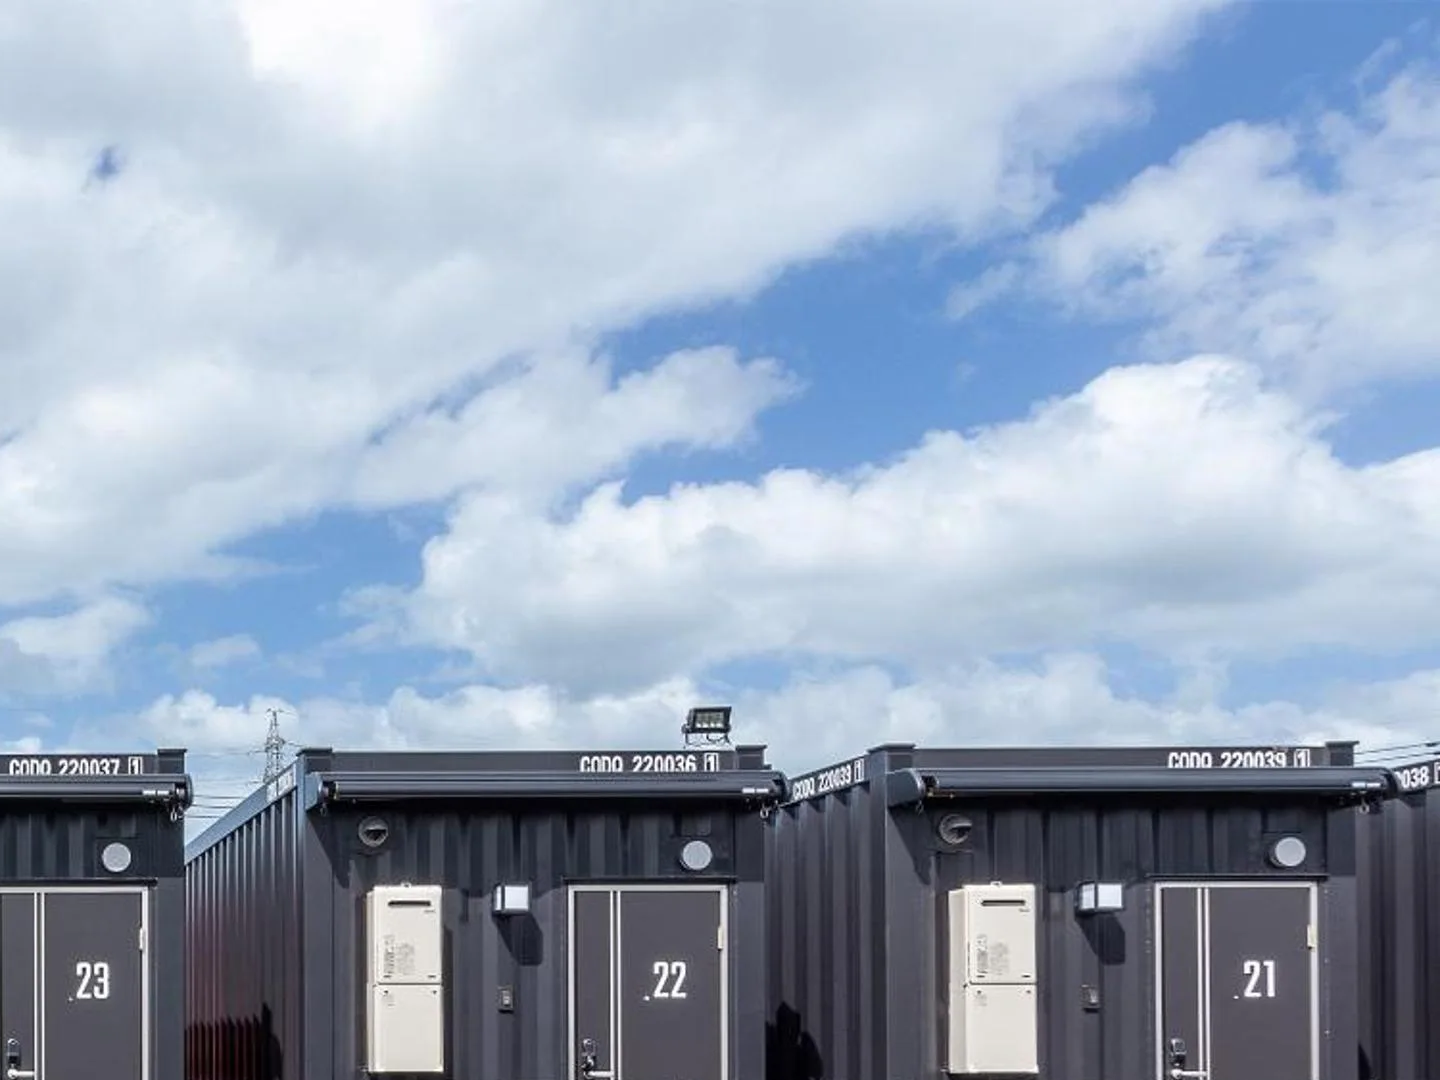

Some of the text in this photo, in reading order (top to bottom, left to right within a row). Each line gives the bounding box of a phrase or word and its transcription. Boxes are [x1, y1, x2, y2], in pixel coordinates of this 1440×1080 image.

[58, 757, 120, 775] 220037
[632, 754, 697, 772] 220036
[1220, 751, 1287, 768] 220039
